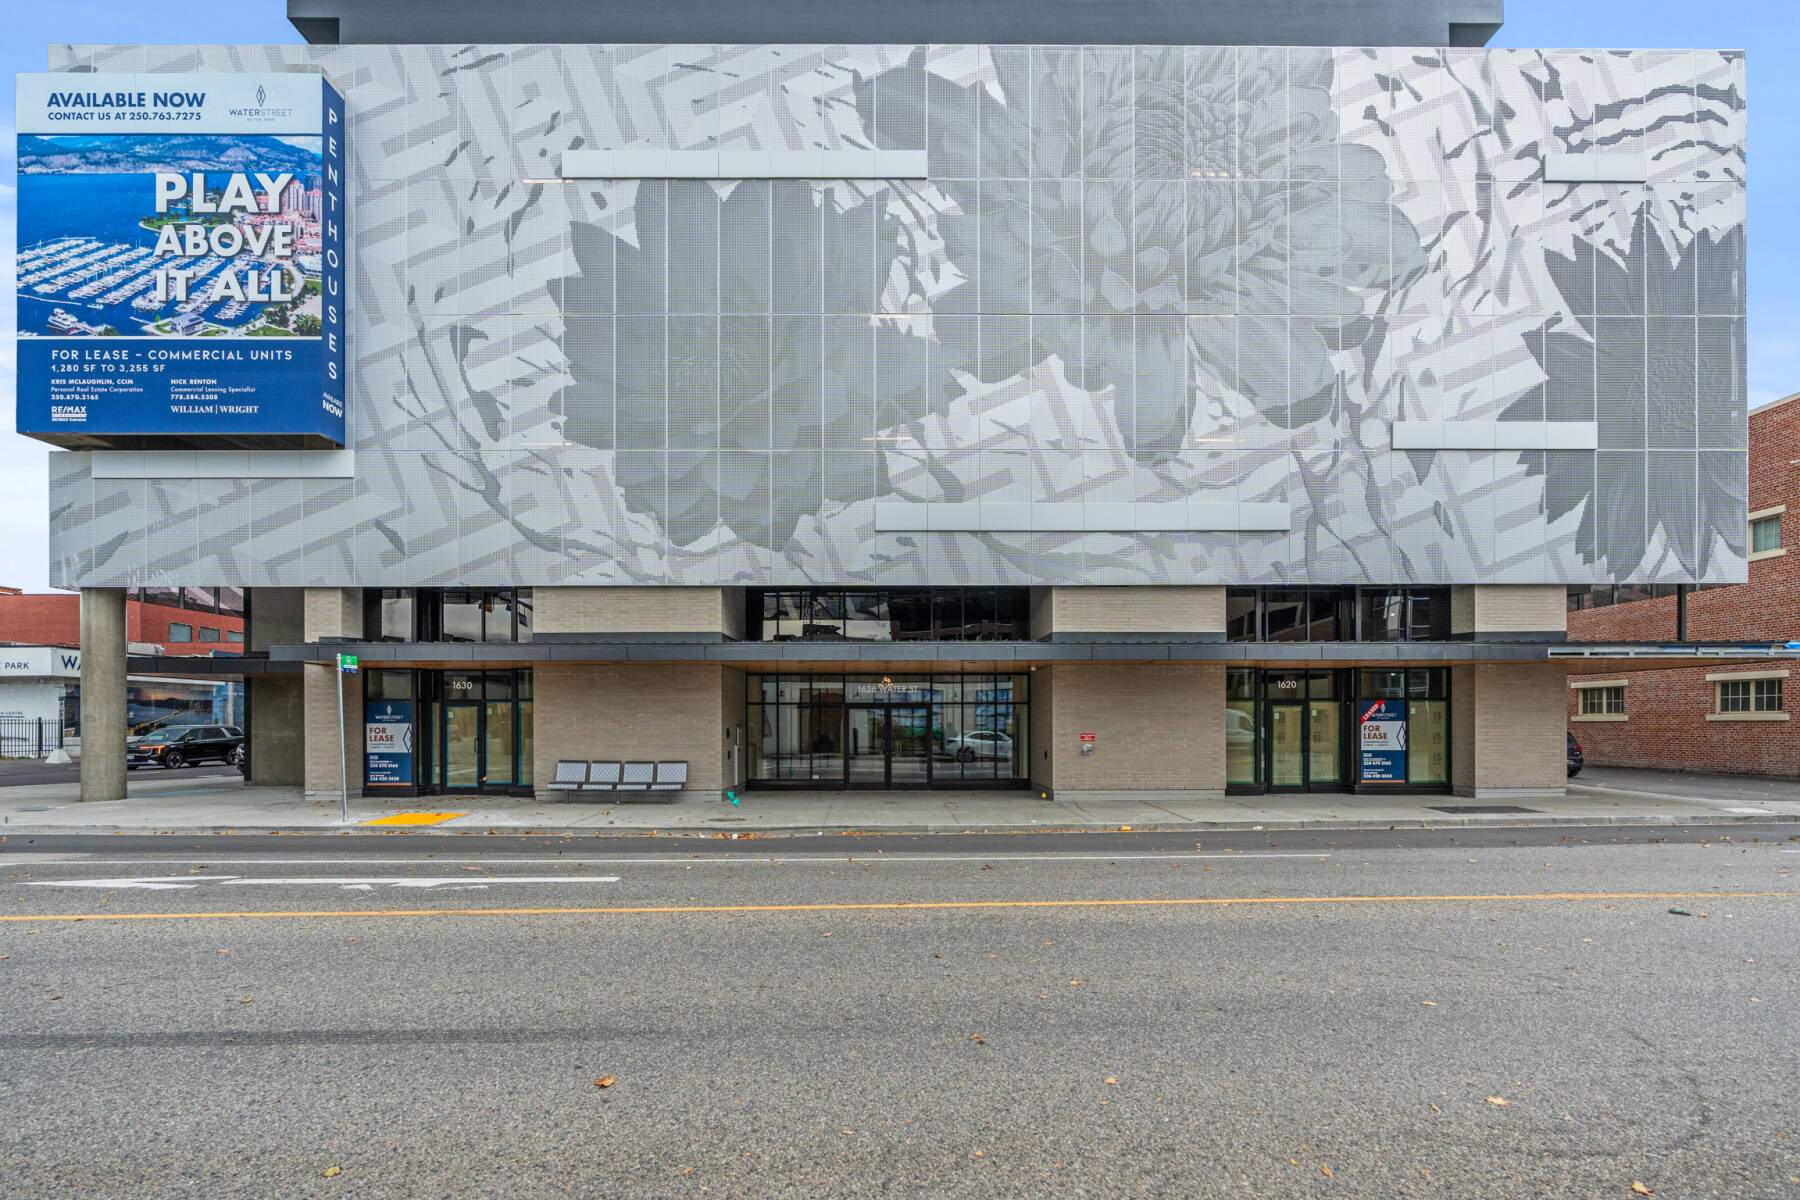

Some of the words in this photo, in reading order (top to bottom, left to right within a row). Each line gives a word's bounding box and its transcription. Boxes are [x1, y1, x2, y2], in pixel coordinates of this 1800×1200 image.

[47, 92, 146, 108] AVAILABLE
[153, 92, 206, 108] NOW
[48, 112, 95, 121] CONTACT
[98, 112, 111, 121] US
[114, 112, 126, 121] AT
[129, 112, 201, 121] 250.763.7275
[155, 172, 294, 213] PLAY
[153, 223, 292, 258] ABOVE
[327, 106, 339, 380] PENTHOUSES
[155, 269, 194, 302] IT
[210, 268, 292, 302] ALL
[51, 350, 79, 360] FOR
[85, 350, 129, 360] LEASE
[148, 350, 243, 360] COMMERCIAL
[250, 350, 292, 360] UNITS
[51, 364, 79, 373] 1,280
[83, 364, 96, 372] SF
[101, 364, 115, 372] TO
[119, 364, 149, 373] 3,255
[152, 364, 166, 372] SF
[109, 386, 144, 394] Corporation
[51, 406, 87, 414] RE/MAX
[170, 405, 213, 413] WILLIAM
[219, 405, 259, 413] WRIGHT
[322, 399, 343, 418] NOW
[4, 661, 30, 670] PARK
[452, 681, 473, 690] 1630
[858, 685, 877, 693] 1626
[880, 685, 907, 693] WATER
[909, 685, 918, 693] ST
[1277, 680, 1297, 689] 1620
